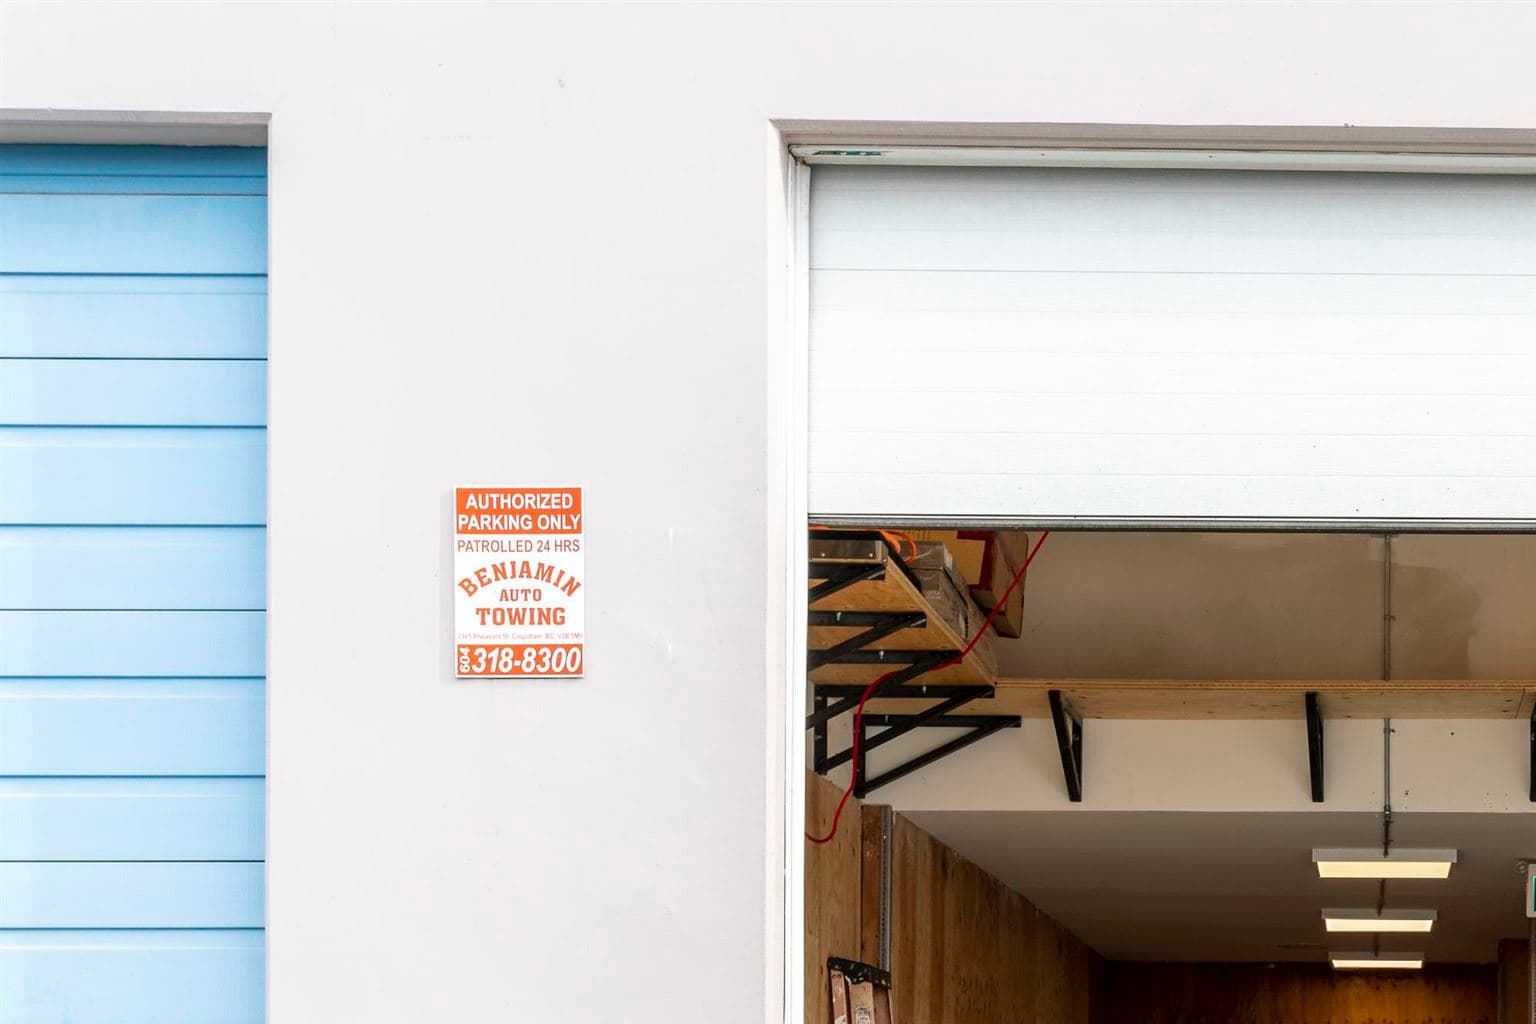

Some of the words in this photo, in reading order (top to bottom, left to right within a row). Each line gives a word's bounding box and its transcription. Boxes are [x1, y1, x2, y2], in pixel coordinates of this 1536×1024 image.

[465, 493, 573, 509] AUTHORIZED
[458, 513, 533, 530] PARKING
[537, 513, 581, 530] ONLY
[457, 540, 533, 552] PATROLLED
[536, 540, 550, 552] 24
[554, 539, 580, 552] HRS
[458, 560, 582, 597] BENJAMIN
[499, 589, 542, 601] AUTO
[475, 607, 566, 625] TOWING
[460, 648, 470, 673] 604
[472, 647, 581, 673] 318-8300
